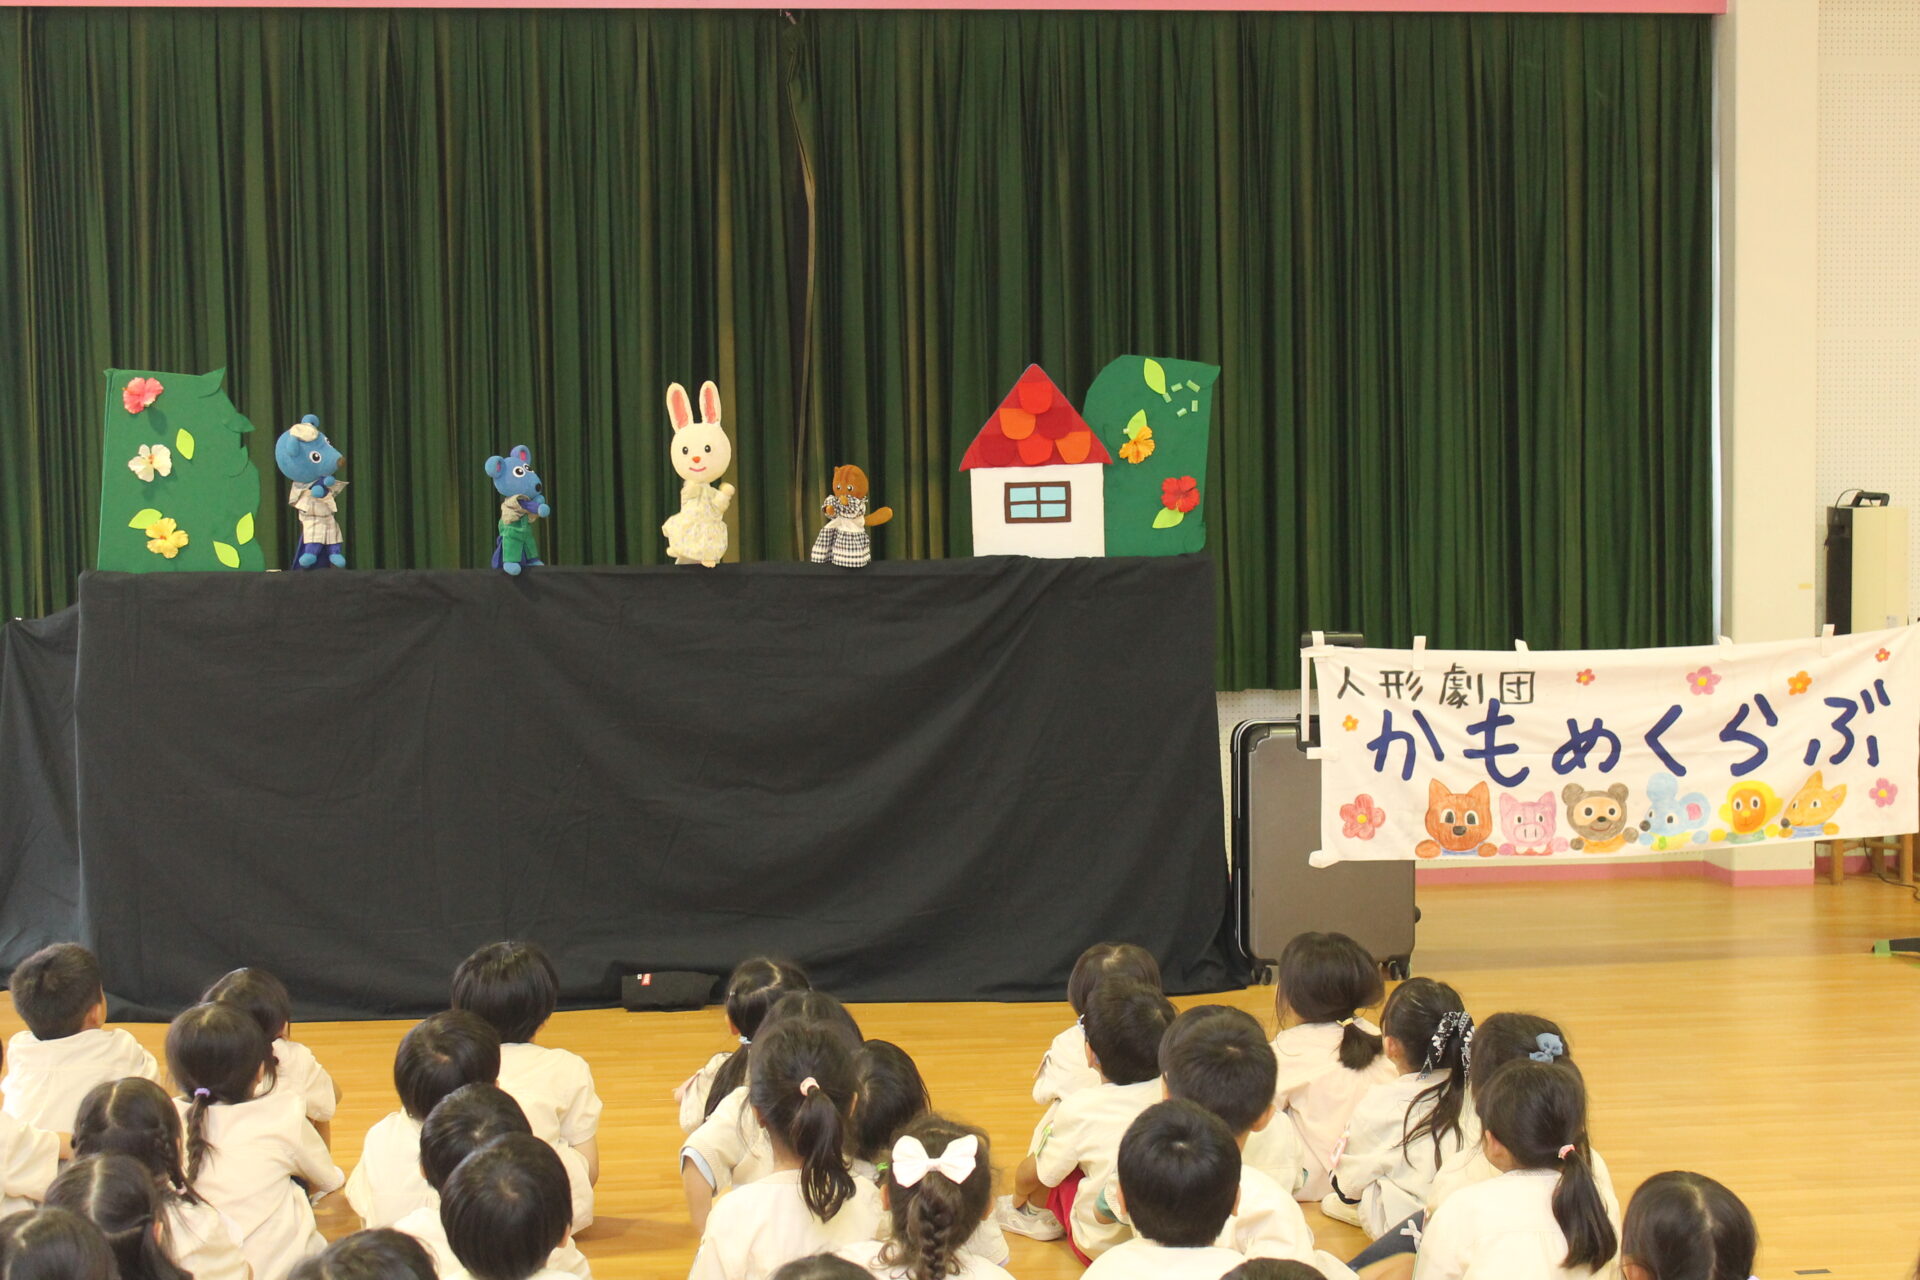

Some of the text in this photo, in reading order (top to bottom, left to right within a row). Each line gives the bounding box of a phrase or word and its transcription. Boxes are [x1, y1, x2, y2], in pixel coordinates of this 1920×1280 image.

[1337, 662, 1535, 709] 人形劇団
[1366, 679, 1892, 787] かもめくらぶ
